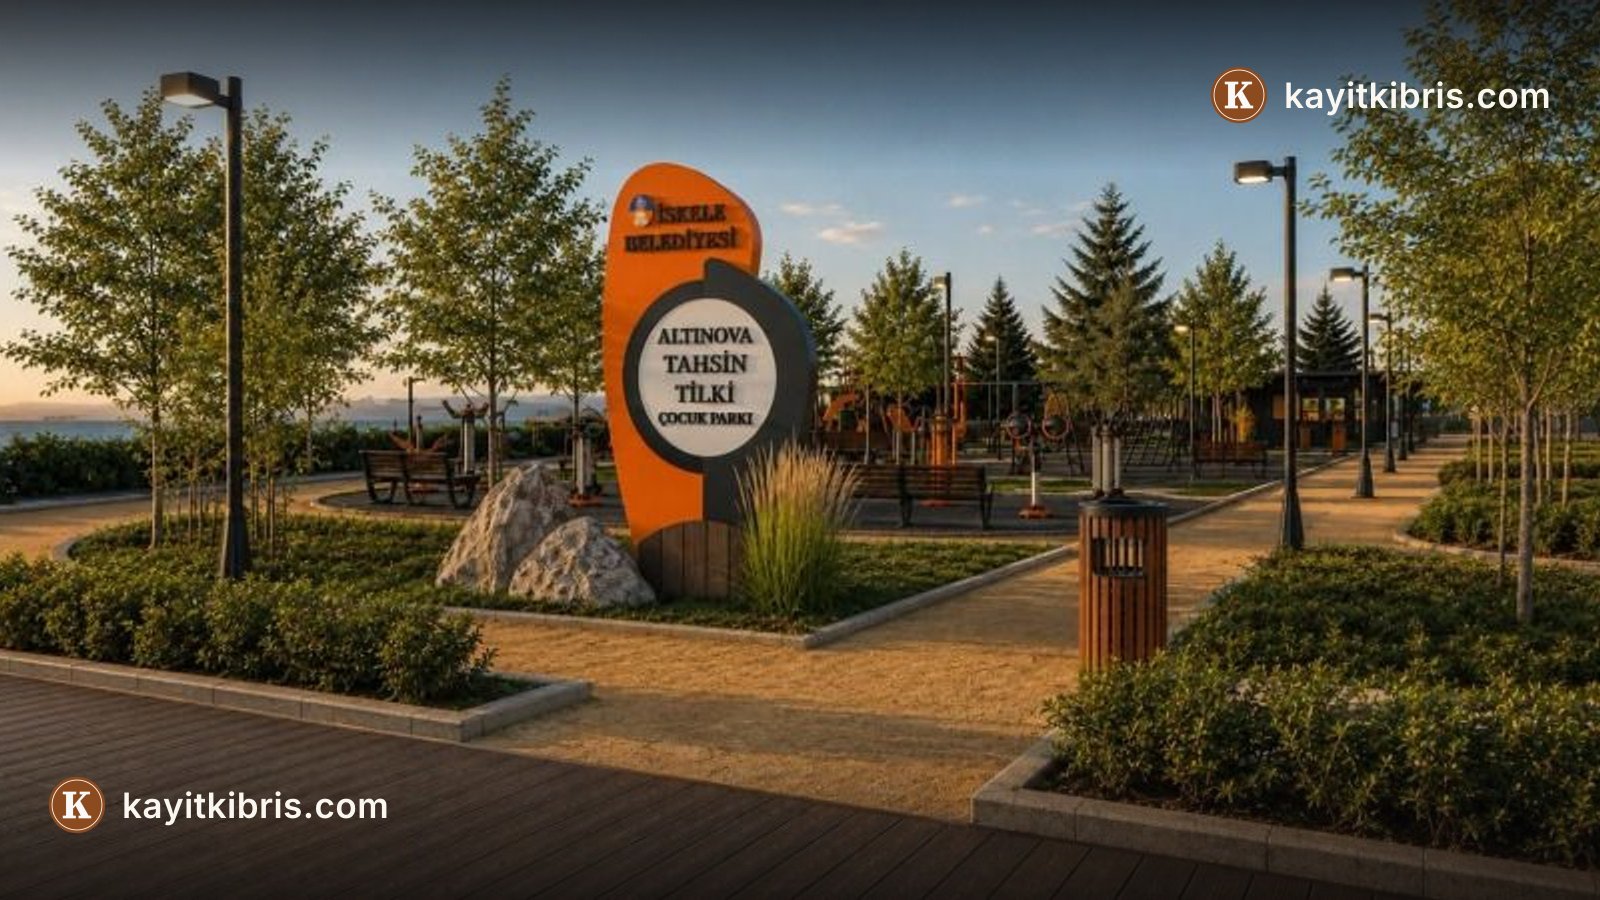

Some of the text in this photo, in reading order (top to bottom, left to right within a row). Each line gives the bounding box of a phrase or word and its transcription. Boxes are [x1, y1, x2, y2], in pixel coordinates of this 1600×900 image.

[626, 228, 737, 252] BELEDİYESİ
[658, 327, 753, 345] ALTINOVA
[664, 351, 748, 374] TAHSİN
[675, 380, 735, 403] TİLKİ
[658, 411, 753, 427] ÇOCUK PARKI
